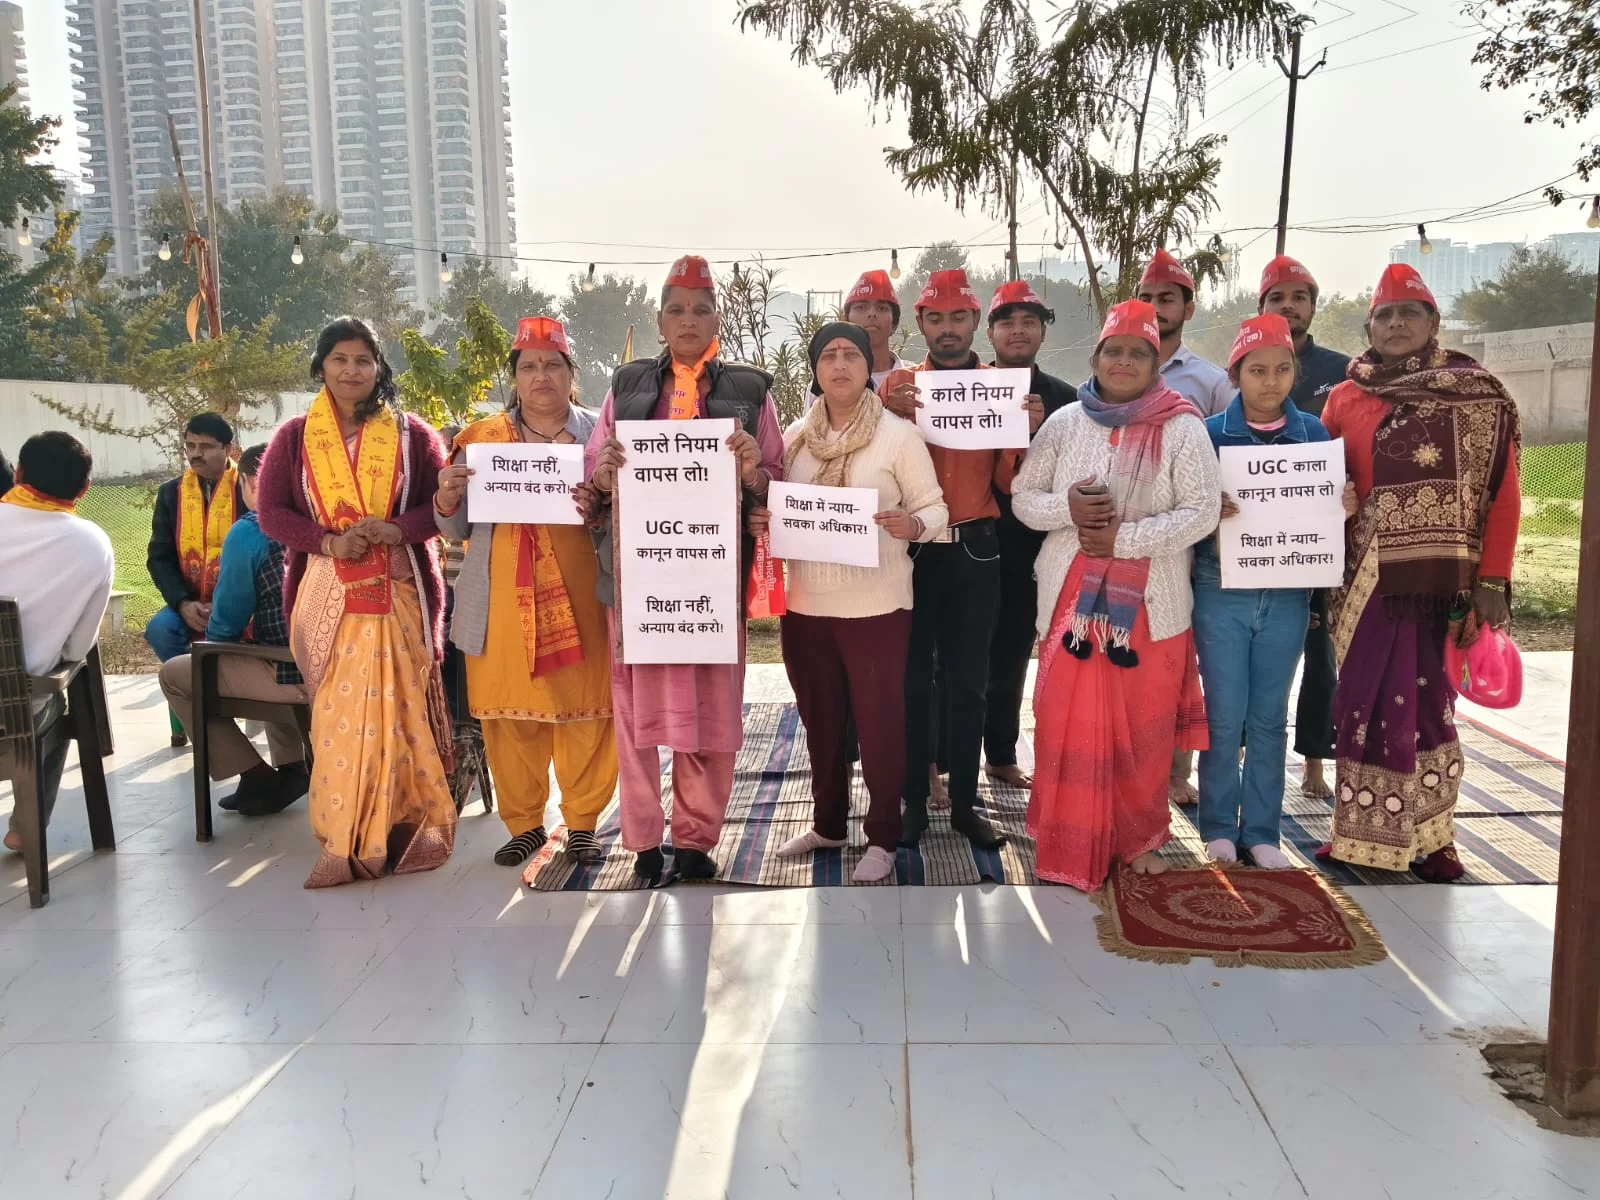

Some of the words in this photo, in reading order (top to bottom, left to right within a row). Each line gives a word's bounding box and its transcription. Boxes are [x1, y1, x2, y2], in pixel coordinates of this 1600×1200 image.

[930, 382, 967, 403] काले
[971, 382, 1015, 401] नियम
[930, 416, 974, 429] वापस
[977, 408, 1002, 428] लो!
[632, 433, 670, 453] काले
[674, 433, 719, 453] नियम
[492, 456, 528, 473] शिक्षा
[531, 456, 560, 475] नहीं,
[633, 467, 679, 482] वापस
[682, 461, 708, 481] लो!
[1248, 459, 1287, 475] UGC
[1292, 460, 1327, 472] काला
[484, 482, 522, 492] अन्याय
[1237, 488, 1276, 503] कानून
[1279, 486, 1316, 498] वापस
[1317, 481, 1335, 496] लो
[785, 495, 813, 512] शिक्षा
[815, 498, 825, 512] में
[646, 520, 683, 535] UGC
[688, 524, 720, 535] काला
[782, 518, 815, 530] सबका
[819, 519, 867, 534] अधिकार!
[1240, 533, 1273, 548] शिक्षा
[1276, 531, 1287, 545] में
[636, 548, 672, 562] कानून
[675, 548, 709, 559] वापस
[710, 544, 726, 560] लो
[1237, 557, 1276, 568] सबका
[1279, 551, 1333, 566] अधिकार!
[645, 596, 682, 614] शिक्षा
[684, 595, 713, 614] नहीं,
[639, 623, 675, 633] अन्याय
